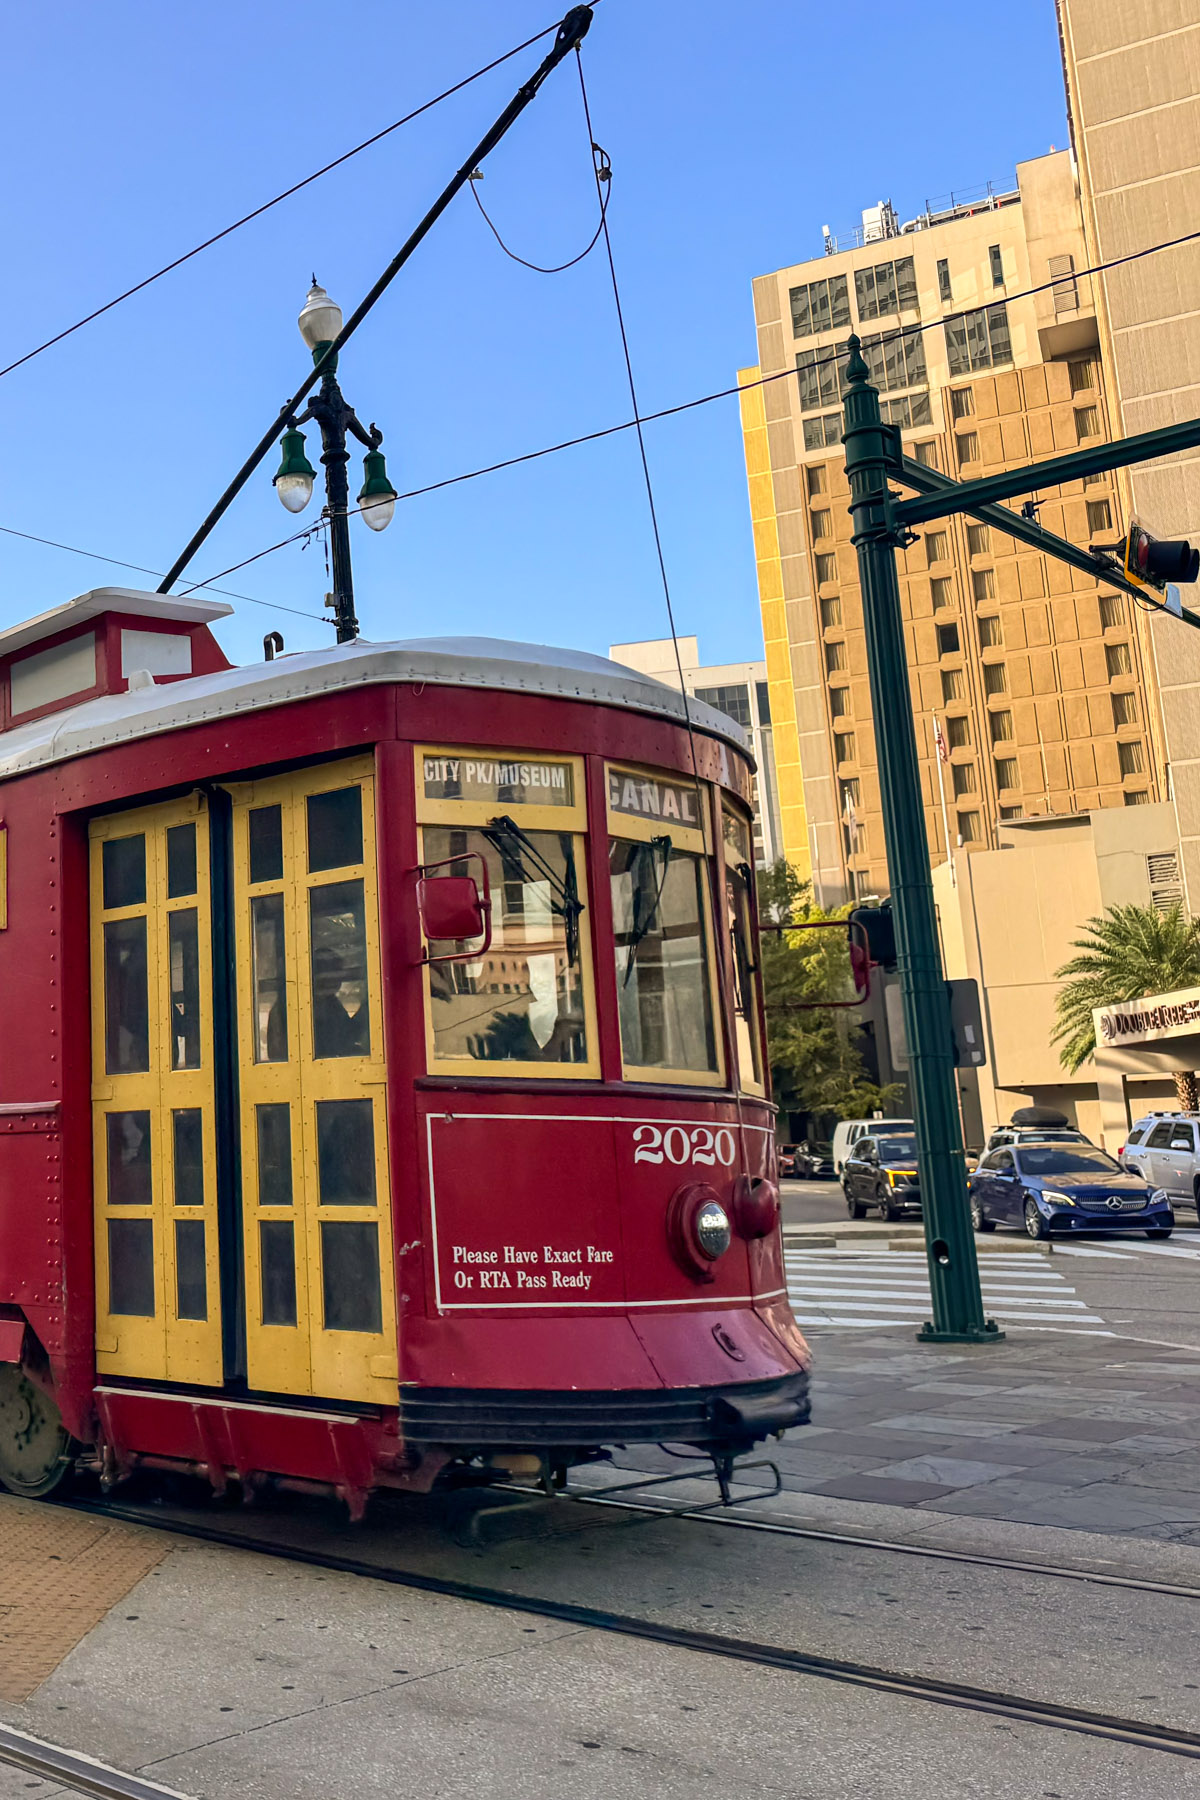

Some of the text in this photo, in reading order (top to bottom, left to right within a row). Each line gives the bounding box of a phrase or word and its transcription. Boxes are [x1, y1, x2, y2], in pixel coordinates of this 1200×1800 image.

[423, 759, 565, 788] CITY PK/MUSEUM
[632, 1125, 736, 1166] 2020
[452, 1245, 614, 1264] Please Have Exact Fare
[454, 1270, 592, 1290] Or RTA Pass Ready
